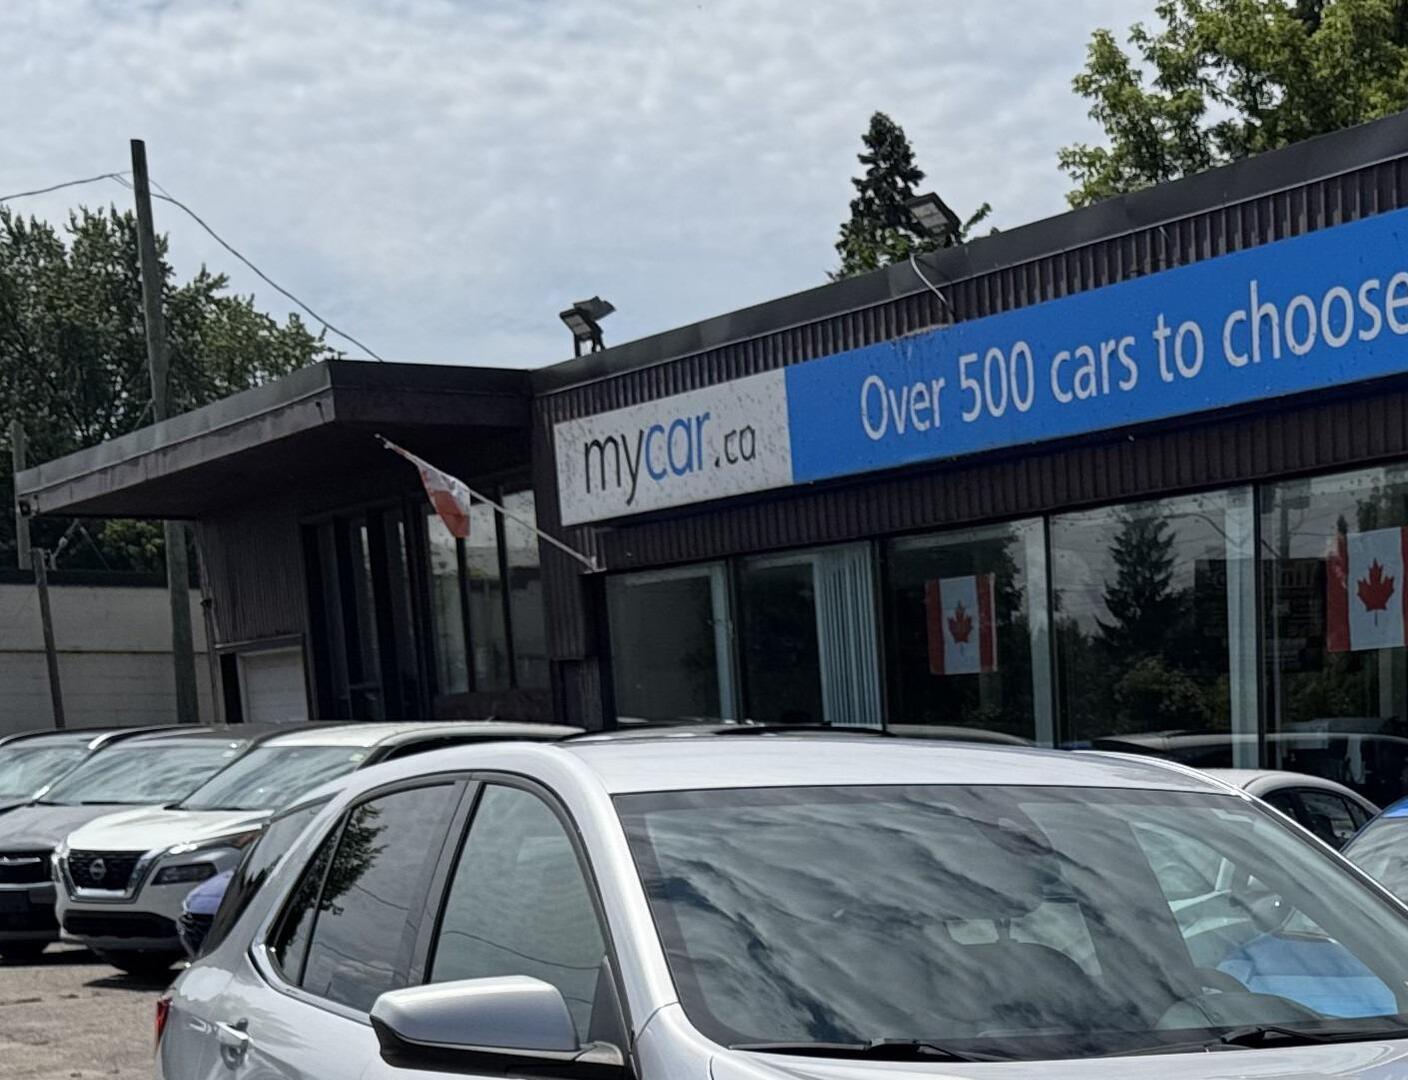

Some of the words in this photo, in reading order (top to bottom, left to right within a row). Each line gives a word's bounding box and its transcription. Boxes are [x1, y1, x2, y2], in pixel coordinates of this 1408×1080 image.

[860, 375, 946, 441] Over
[958, 340, 1035, 423] 500
[1050, 336, 1139, 404] cars
[1152, 313, 1205, 383] to
[583, 411, 757, 507] mycar.ca
